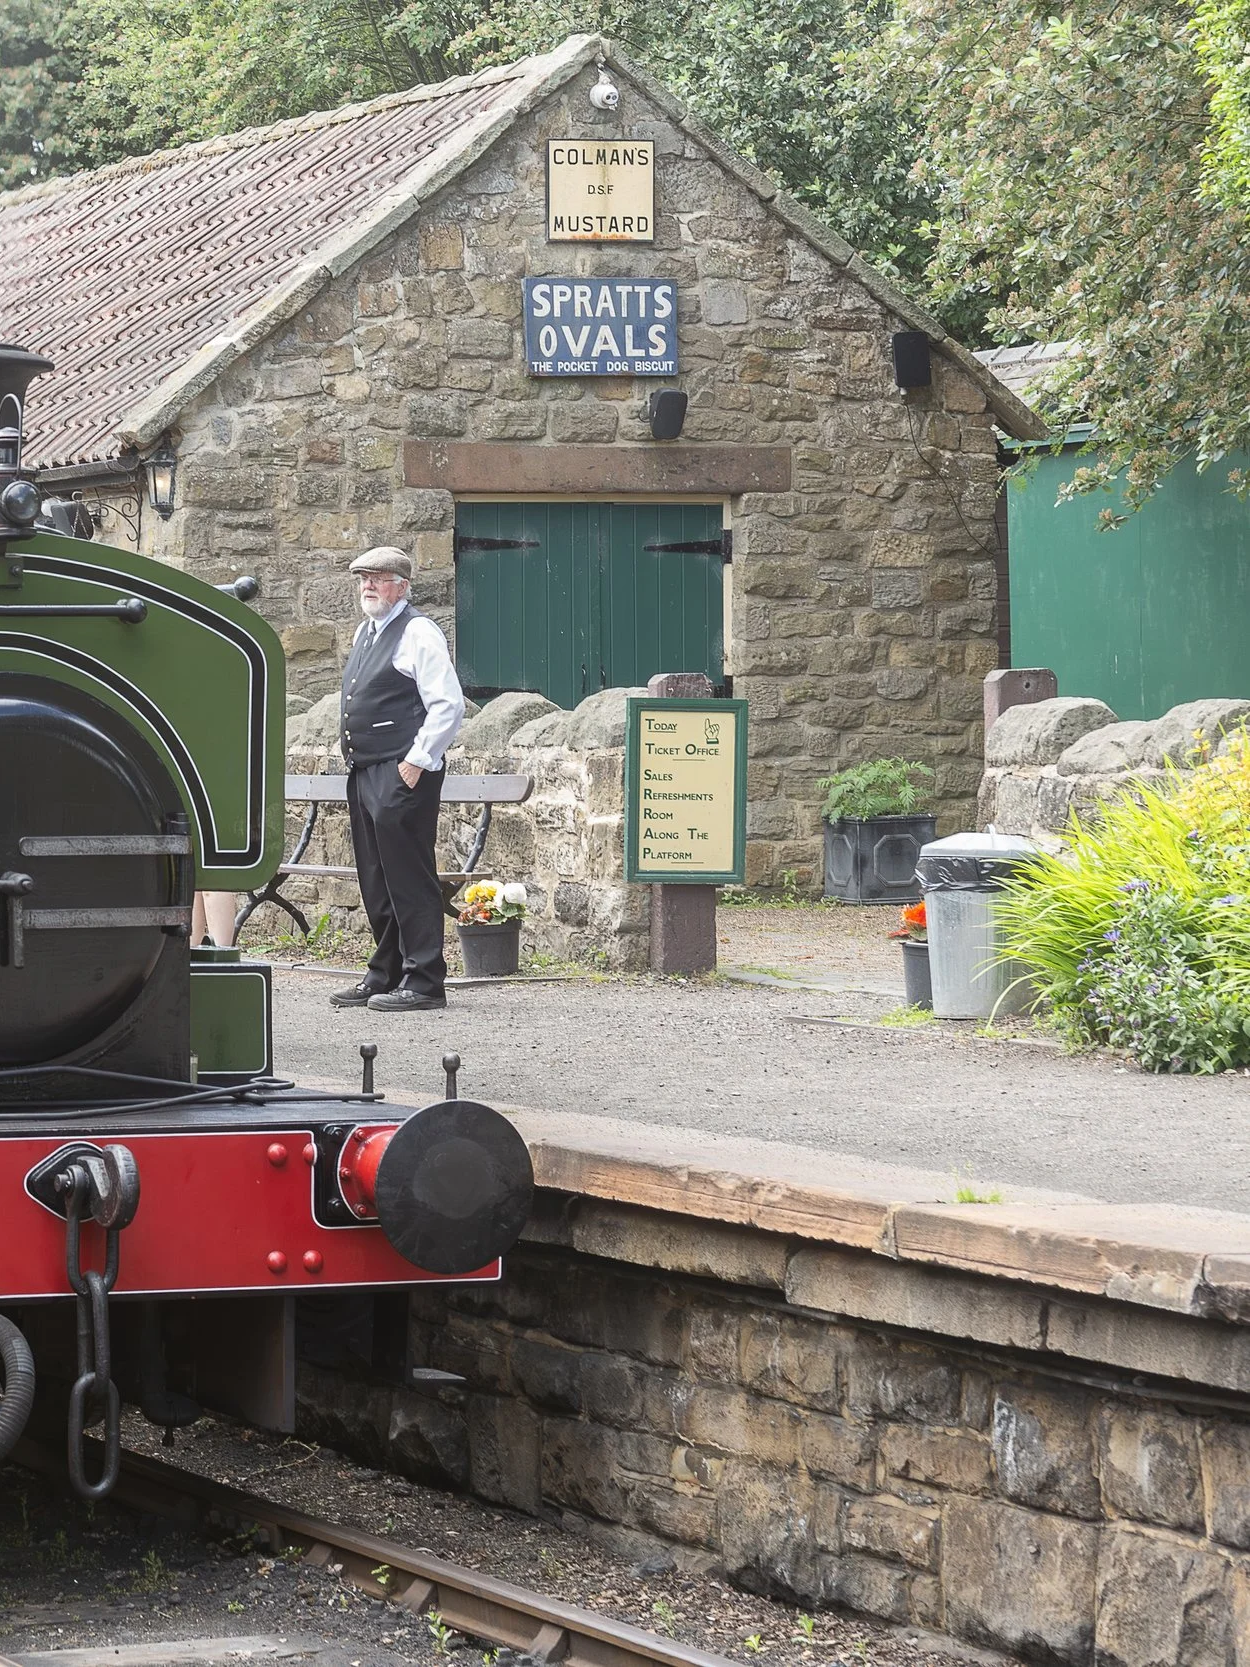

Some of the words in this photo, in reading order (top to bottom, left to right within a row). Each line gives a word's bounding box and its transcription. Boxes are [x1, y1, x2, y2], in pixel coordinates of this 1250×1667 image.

[553, 147, 649, 166] COLMAN'S
[553, 215, 648, 233] MUSTARD
[532, 283, 673, 318] SPRATTS
[539, 324, 667, 358] OVALS
[532, 362, 553, 372] THE
[557, 361, 598, 372] POCKET
[606, 361, 629, 372] DOG
[635, 361, 674, 372] BISCUIT
[645, 718, 678, 731] TODAY
[645, 743, 681, 756] TICKET
[644, 769, 673, 781] SALES
[643, 788, 714, 801] REFRESHMENTS
[643, 808, 673, 820] ROOM
[643, 828, 679, 840] ALONG
[687, 828, 709, 840] THE
[643, 847, 692, 860] PLATFORM
